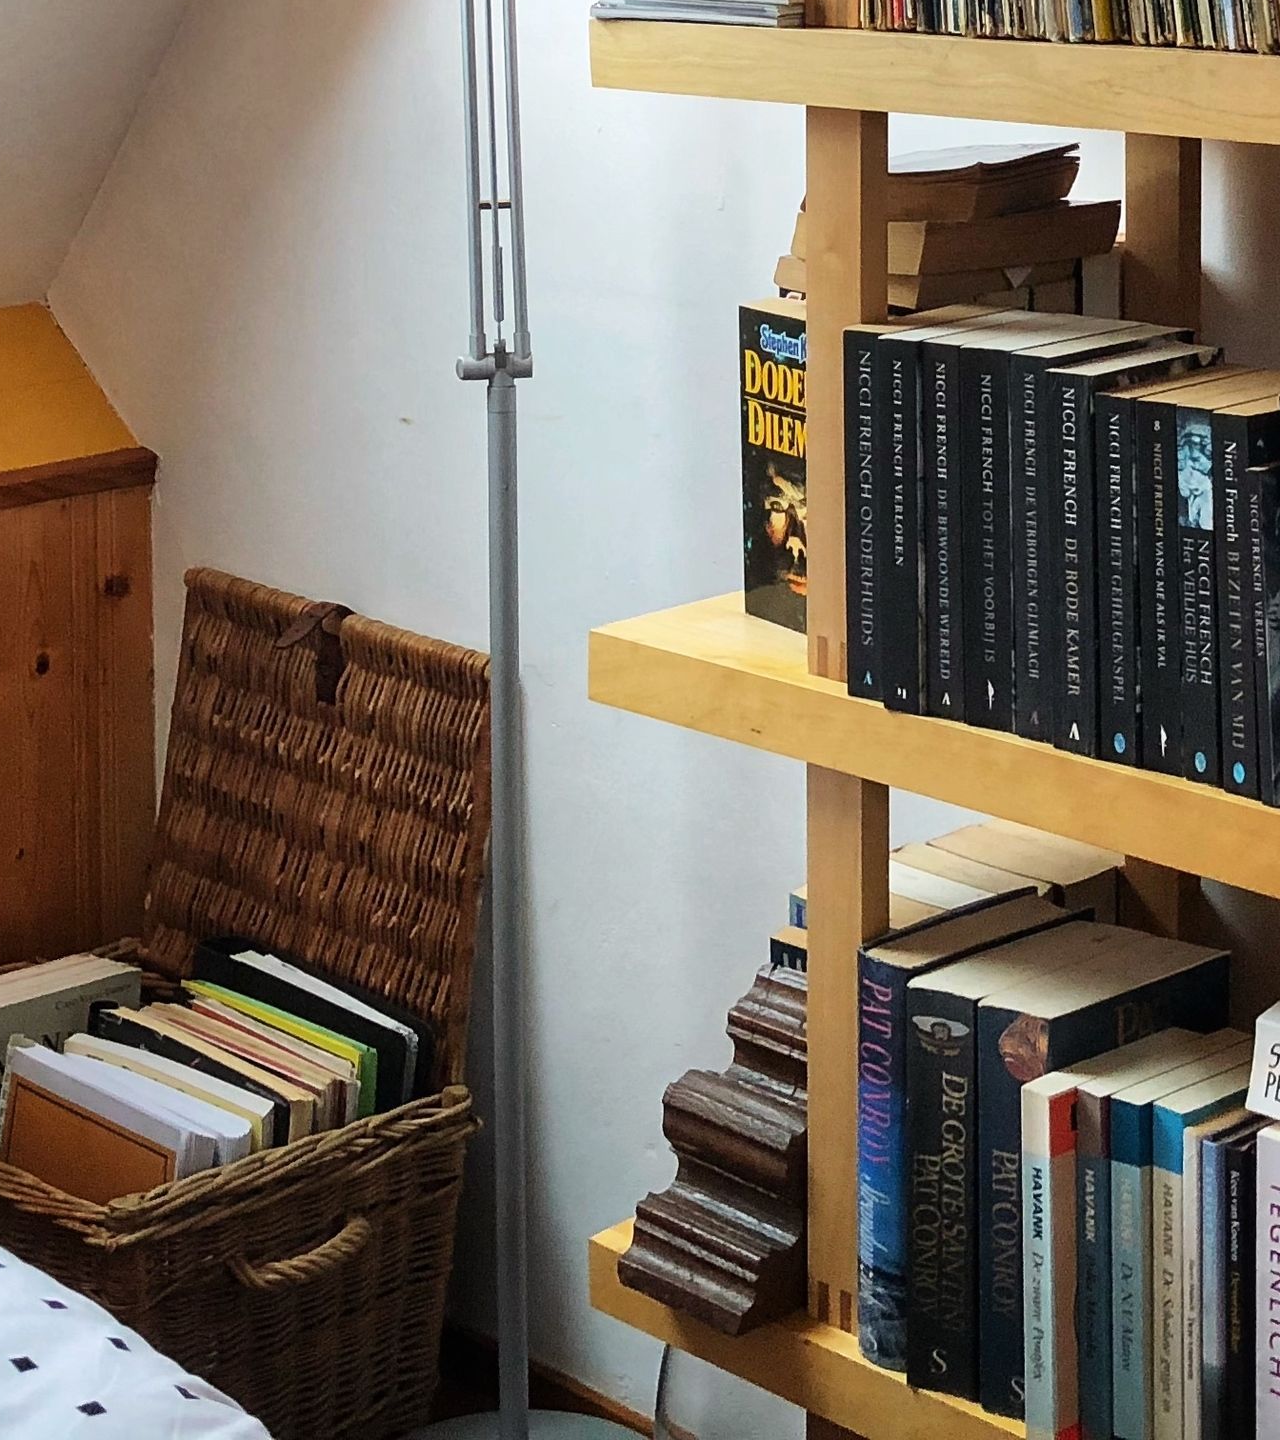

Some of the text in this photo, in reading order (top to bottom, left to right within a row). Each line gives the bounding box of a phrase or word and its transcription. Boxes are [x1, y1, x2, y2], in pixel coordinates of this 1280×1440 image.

[760, 323, 800, 358] Stephen
[859, 349, 874, 647] NICCI FRENCH ONDERHUIDS
[892, 359, 904, 567] NICCI FRENCH VERLOREN
[1023, 371, 1036, 478] NICCI FRENCH
[1108, 412, 1122, 531] NICCI FRENCH
[935, 361, 951, 681] NICCI FRENCH DE BEWOONDE WERELD
[980, 373, 996, 663] NICCI FRENCH TOT HET VOORBIJ IS
[1062, 386, 1081, 697] NICCI FRENCH DE RODE KAMER
[1152, 441, 1167, 668] NICCI FRENCH VANG ME ALS IK VAL
[1248, 493, 1265, 658] NICCI FRENCH VERLIES
[1183, 567, 1197, 684] VEILIGE HUIS
[1197, 539, 1212, 686] NICCI FRENCH
[1223, 440, 1245, 750] Nicci French BEZETEN VAN MIJ
[861, 976, 893, 1039] PAT
[860, 1042, 893, 1165] CONROY
[941, 1071, 969, 1216] DE GROTE
[912, 1155, 942, 1322] PAT CONROY
[991, 1149, 1019, 1319] PAT CONROY
[1032, 1166, 1043, 1242] HAVANK
[1084, 1168, 1096, 1244] HAVANK
[1162, 1183, 1174, 1259] HAVANK
